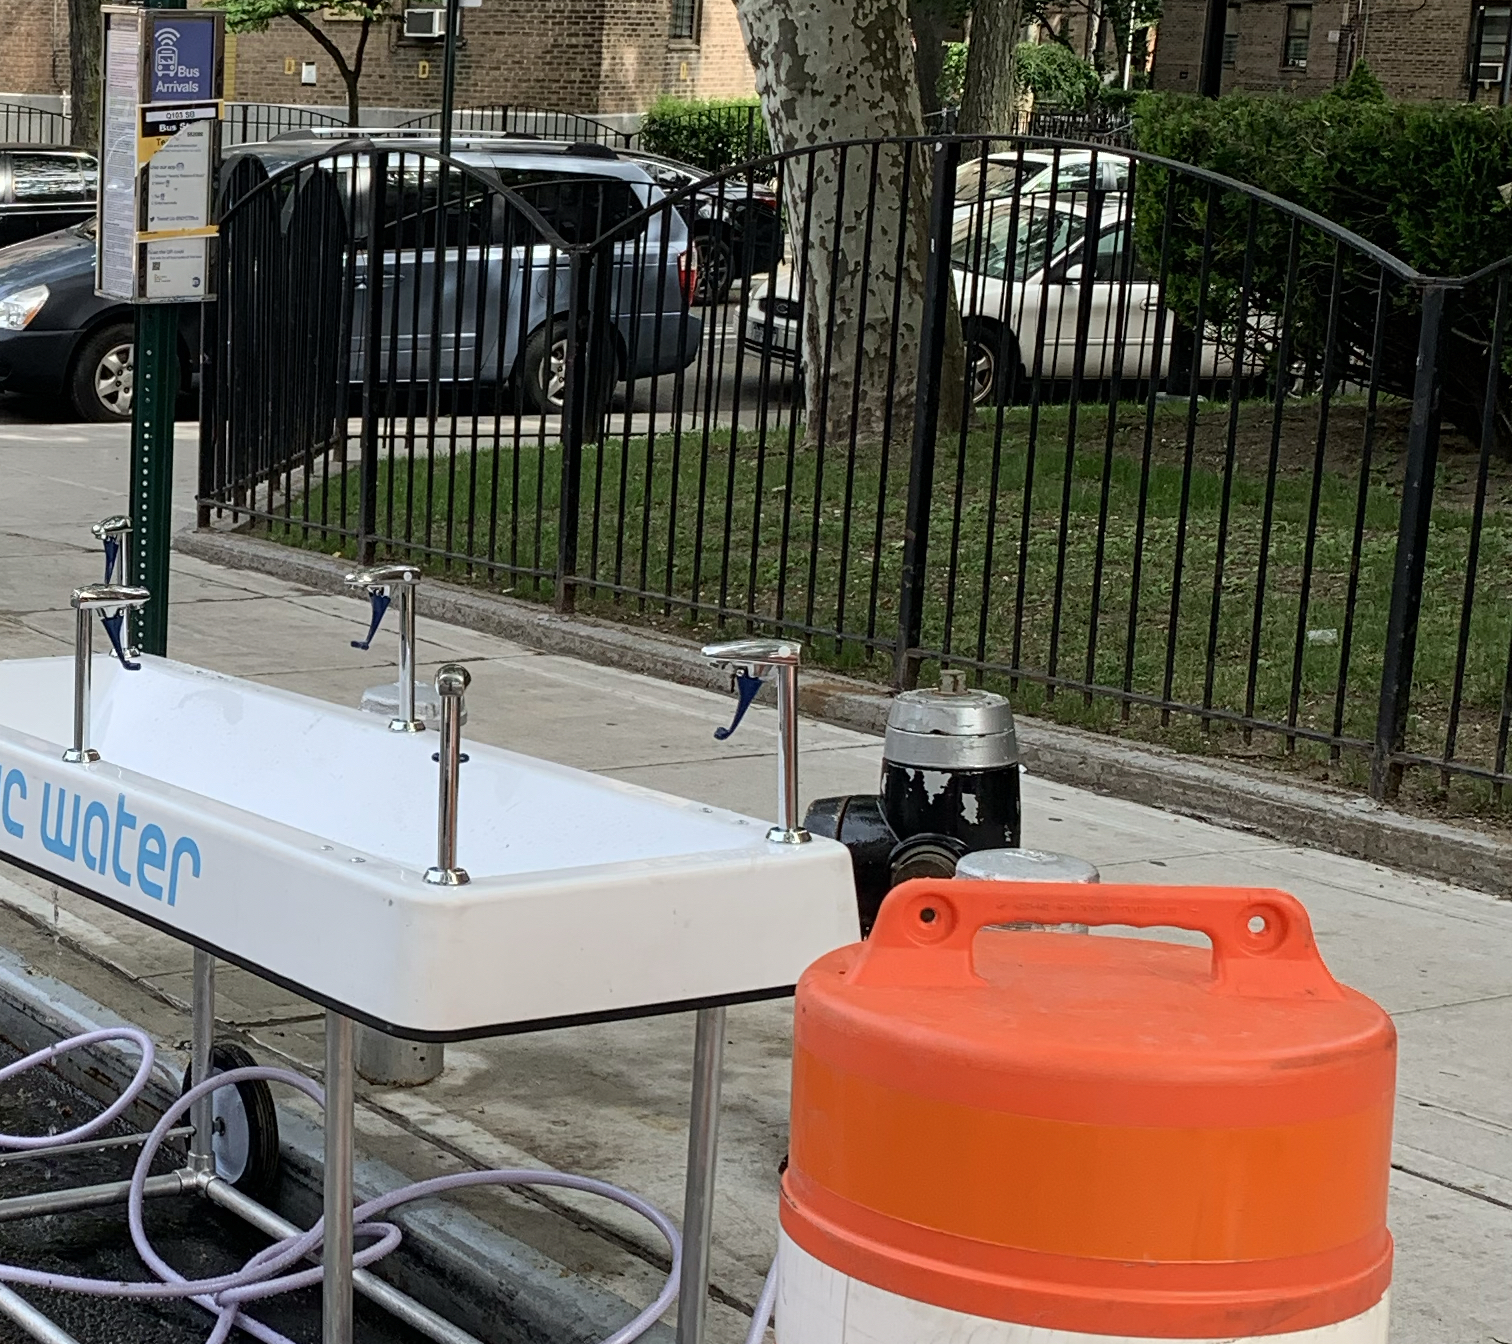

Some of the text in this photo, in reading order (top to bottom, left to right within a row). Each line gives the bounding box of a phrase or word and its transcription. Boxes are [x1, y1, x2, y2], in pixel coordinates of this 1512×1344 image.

[178, 66, 200, 78] Bus
[155, 80, 199, 93] Arrivals
[159, 123, 177, 133] Bus
[39, 781, 201, 908] water
